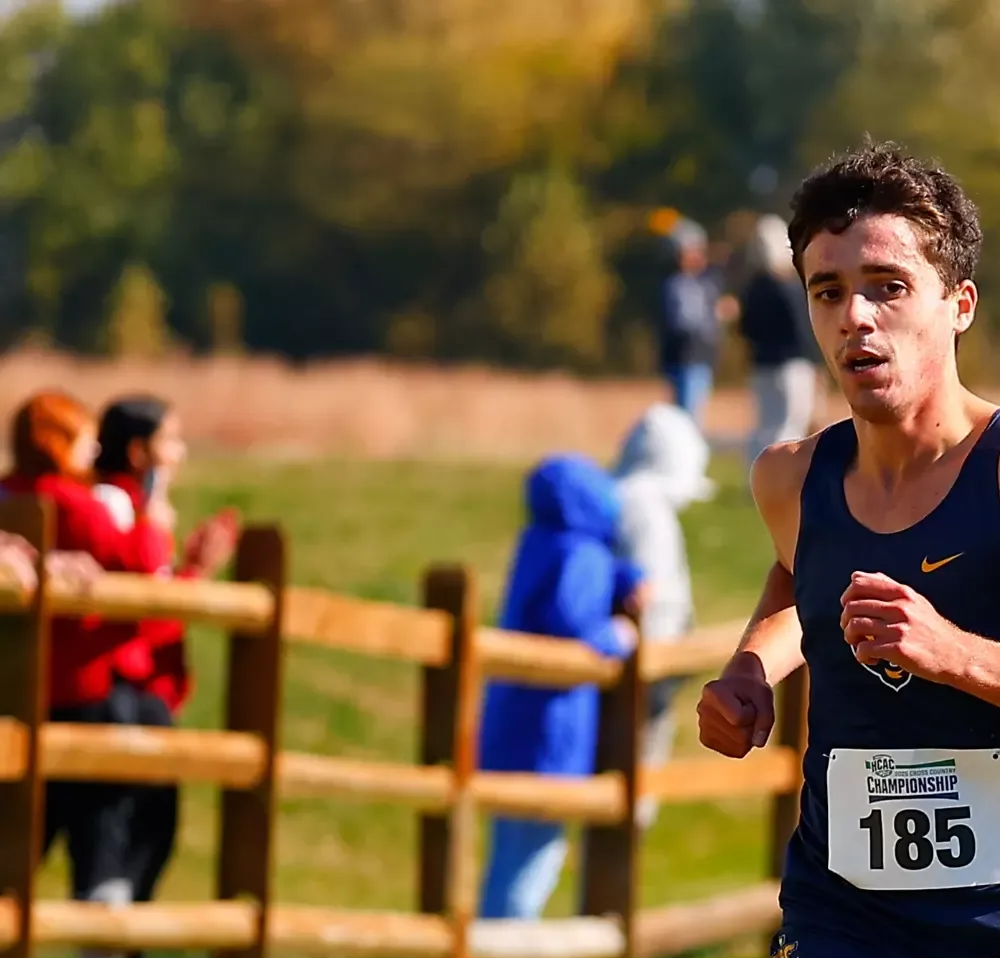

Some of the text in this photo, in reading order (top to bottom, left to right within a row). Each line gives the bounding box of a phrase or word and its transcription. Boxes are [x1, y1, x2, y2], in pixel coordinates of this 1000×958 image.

[872, 758, 894, 773] HCAC
[910, 769, 928, 777] CROSS
[867, 775, 957, 794] CHAMPIONSHIP
[860, 806, 976, 870] 185
